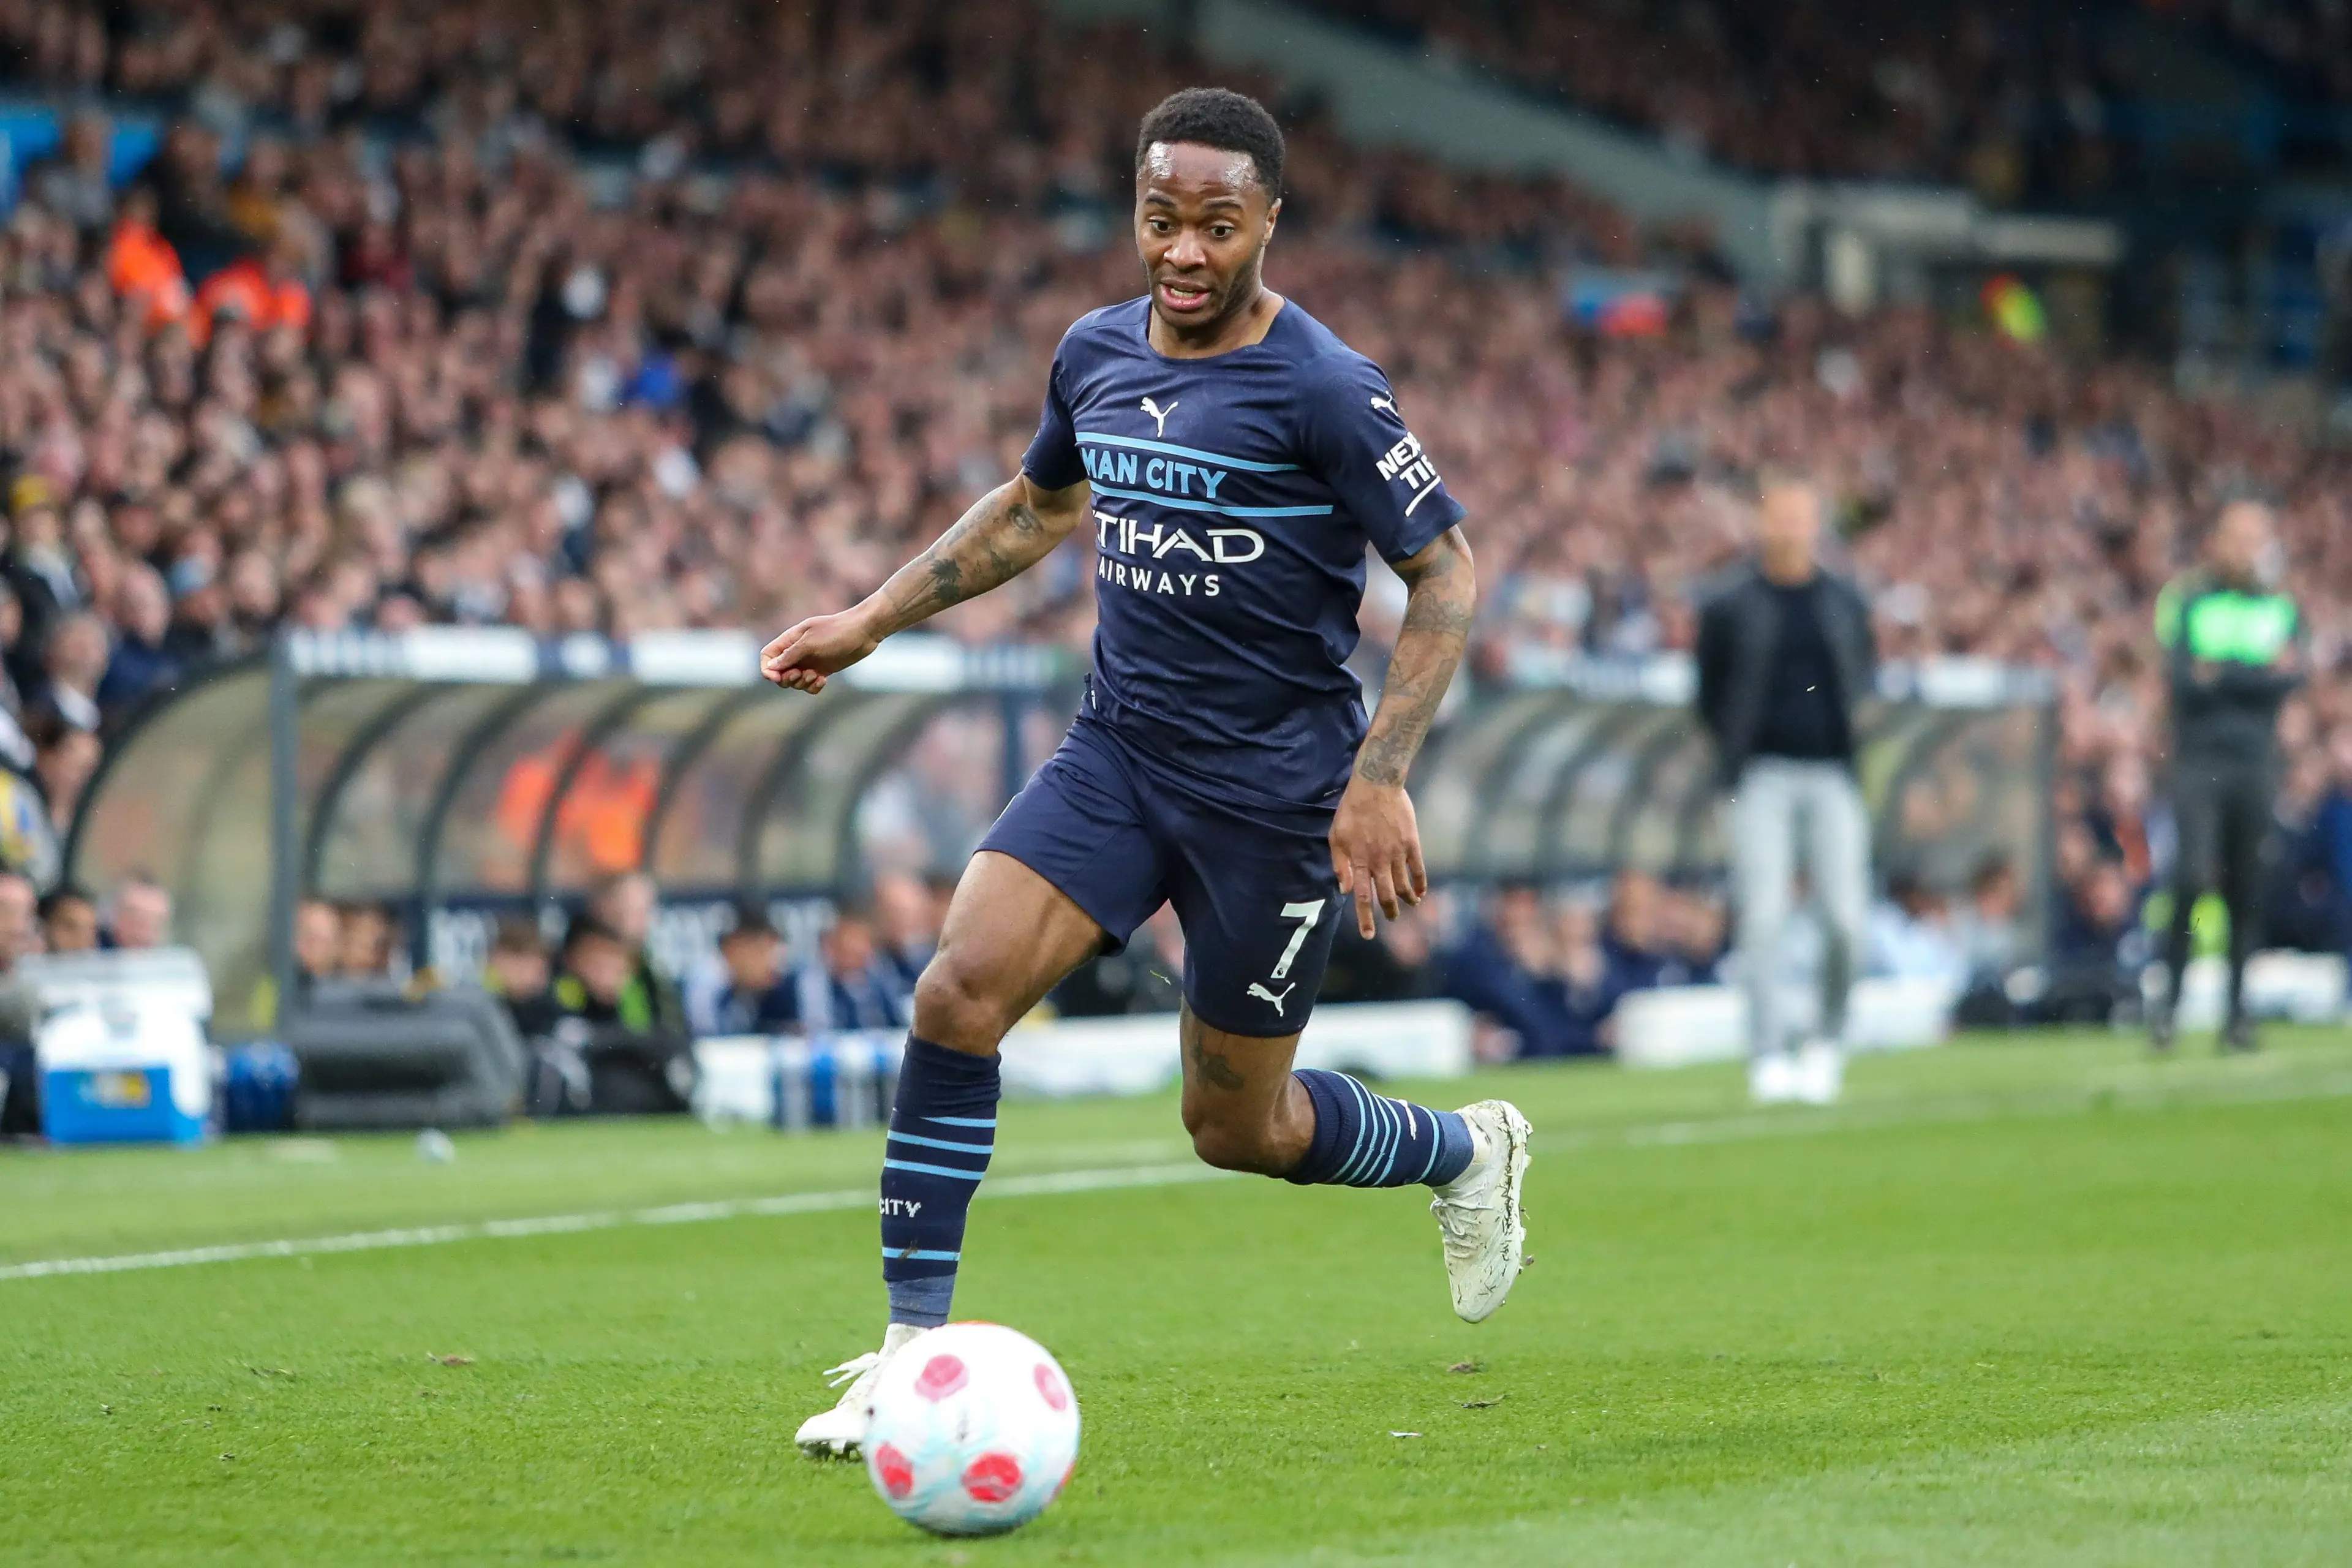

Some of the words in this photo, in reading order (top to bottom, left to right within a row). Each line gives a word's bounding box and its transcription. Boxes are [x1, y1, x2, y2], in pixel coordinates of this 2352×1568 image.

[1080, 447, 1138, 484] MAN
[1145, 458, 1227, 499] CITY
[1091, 509, 1265, 564] TIHAD
[1098, 556, 1220, 597] AIRWAYS
[1270, 899, 1326, 979] 7
[878, 1197, 922, 1218] CITY
